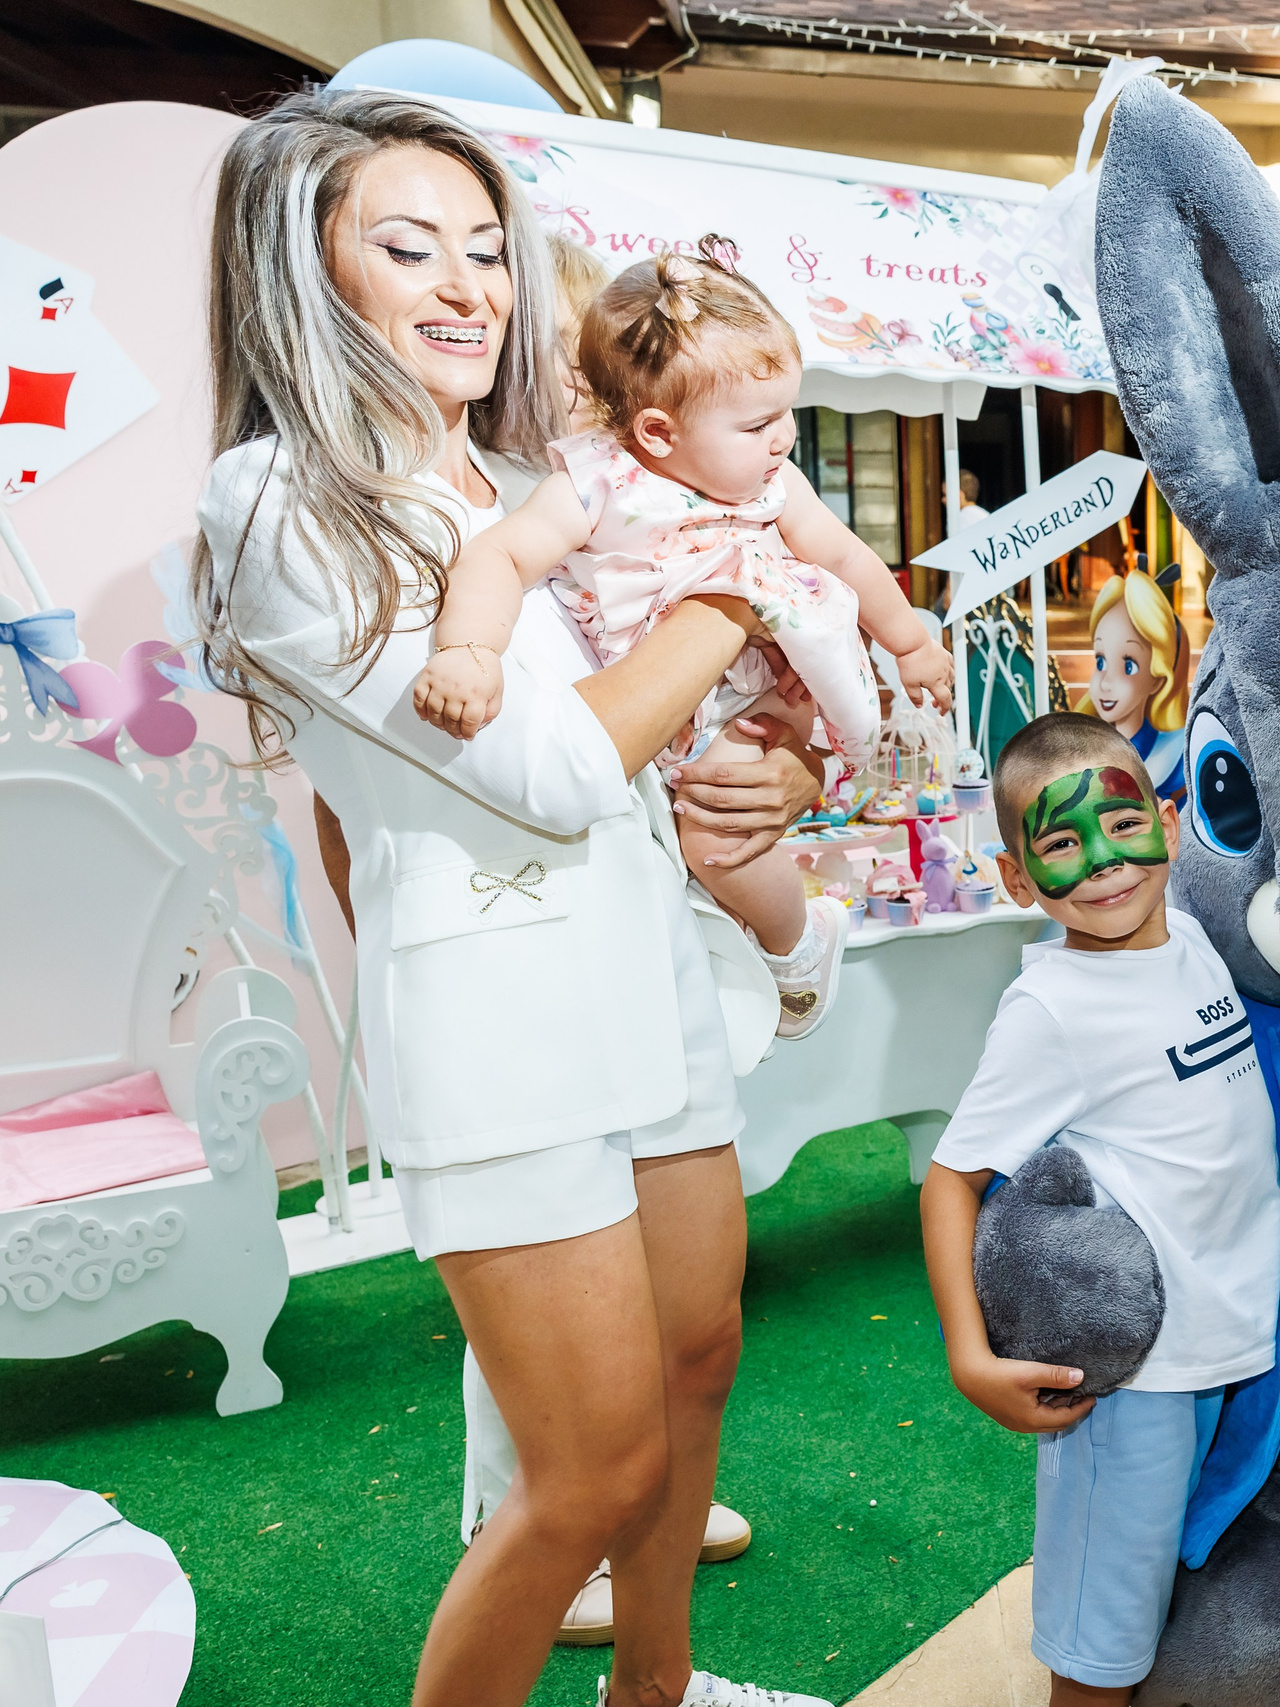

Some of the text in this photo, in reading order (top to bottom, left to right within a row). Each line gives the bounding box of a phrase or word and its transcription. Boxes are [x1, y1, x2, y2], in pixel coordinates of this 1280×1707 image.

[787, 233, 832, 284] &
[860, 253, 989, 288] treats
[1196, 996, 1234, 1026] BOSS
[1226, 1060, 1257, 1083] STEREO
